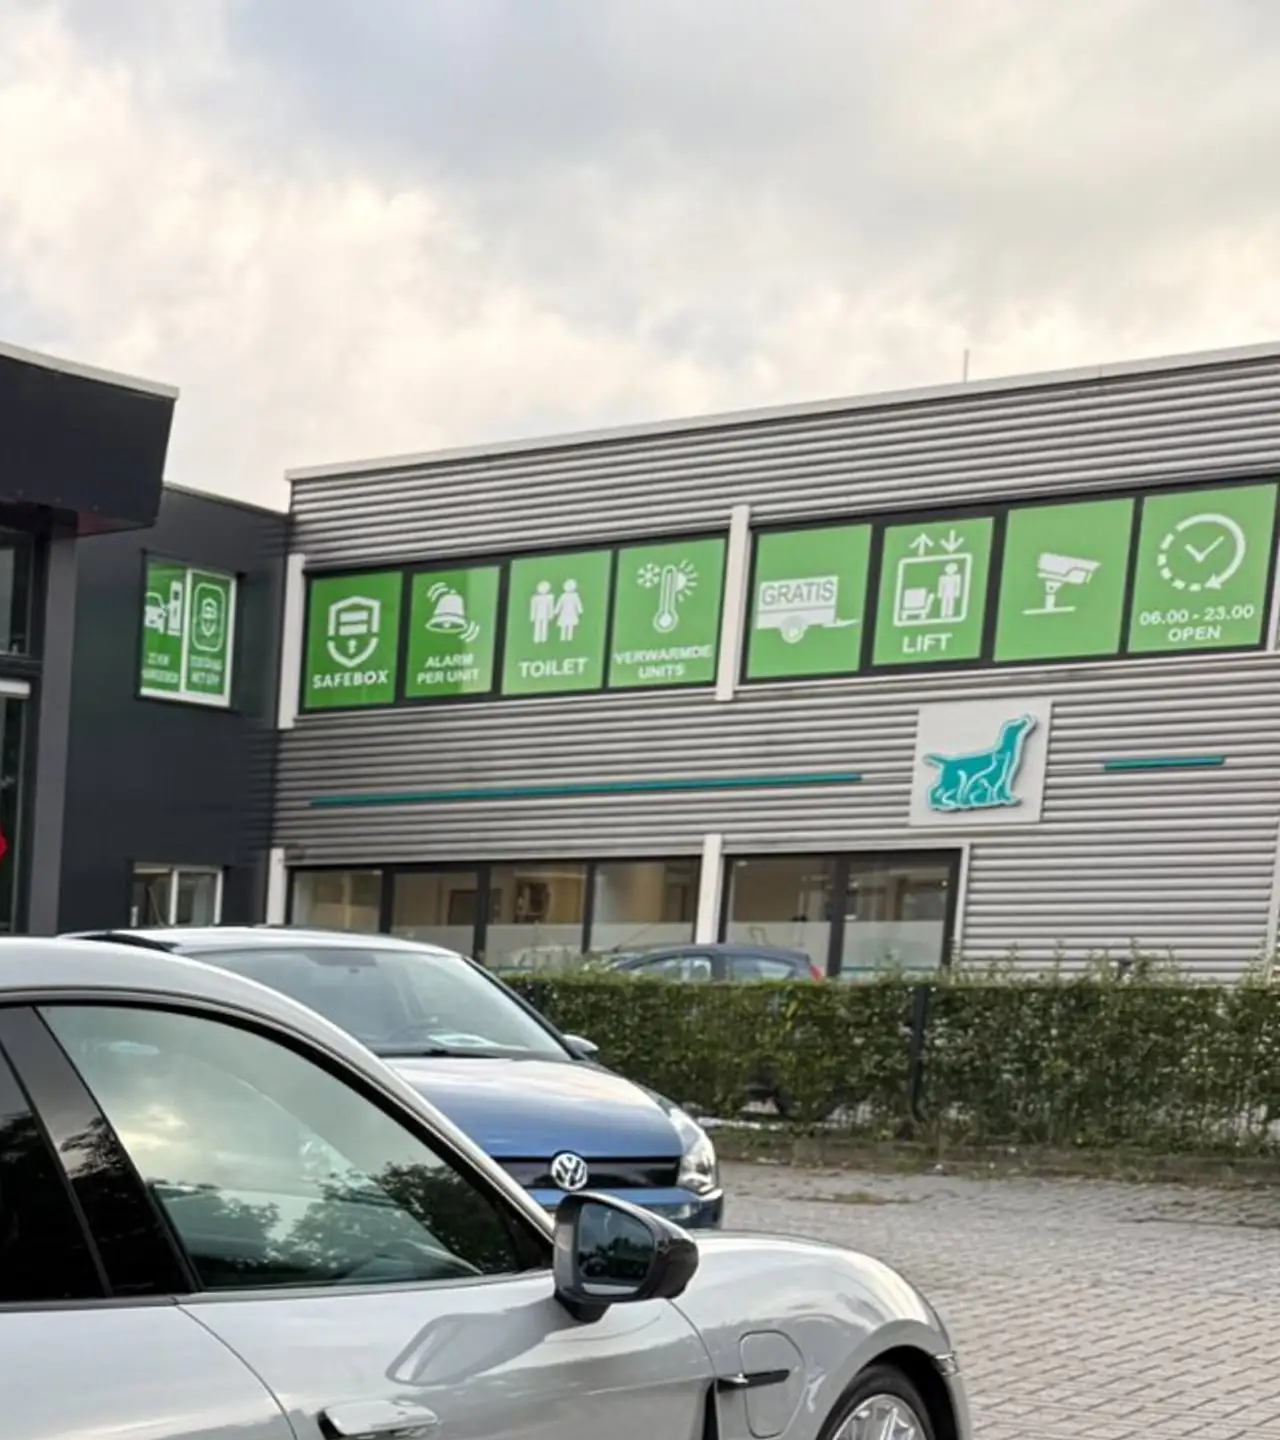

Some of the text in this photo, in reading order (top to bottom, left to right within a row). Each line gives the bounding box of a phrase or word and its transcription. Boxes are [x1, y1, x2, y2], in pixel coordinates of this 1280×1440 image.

[761, 580, 835, 606] GRATIS
[1140, 608, 1189, 626] 06.00
[1203, 603, 1255, 621] 23.00
[902, 632, 953, 653] LIFT
[1168, 624, 1221, 642] OPEN
[518, 656, 589, 678] TOILET
[313, 669, 389, 689] SAFEBOX
